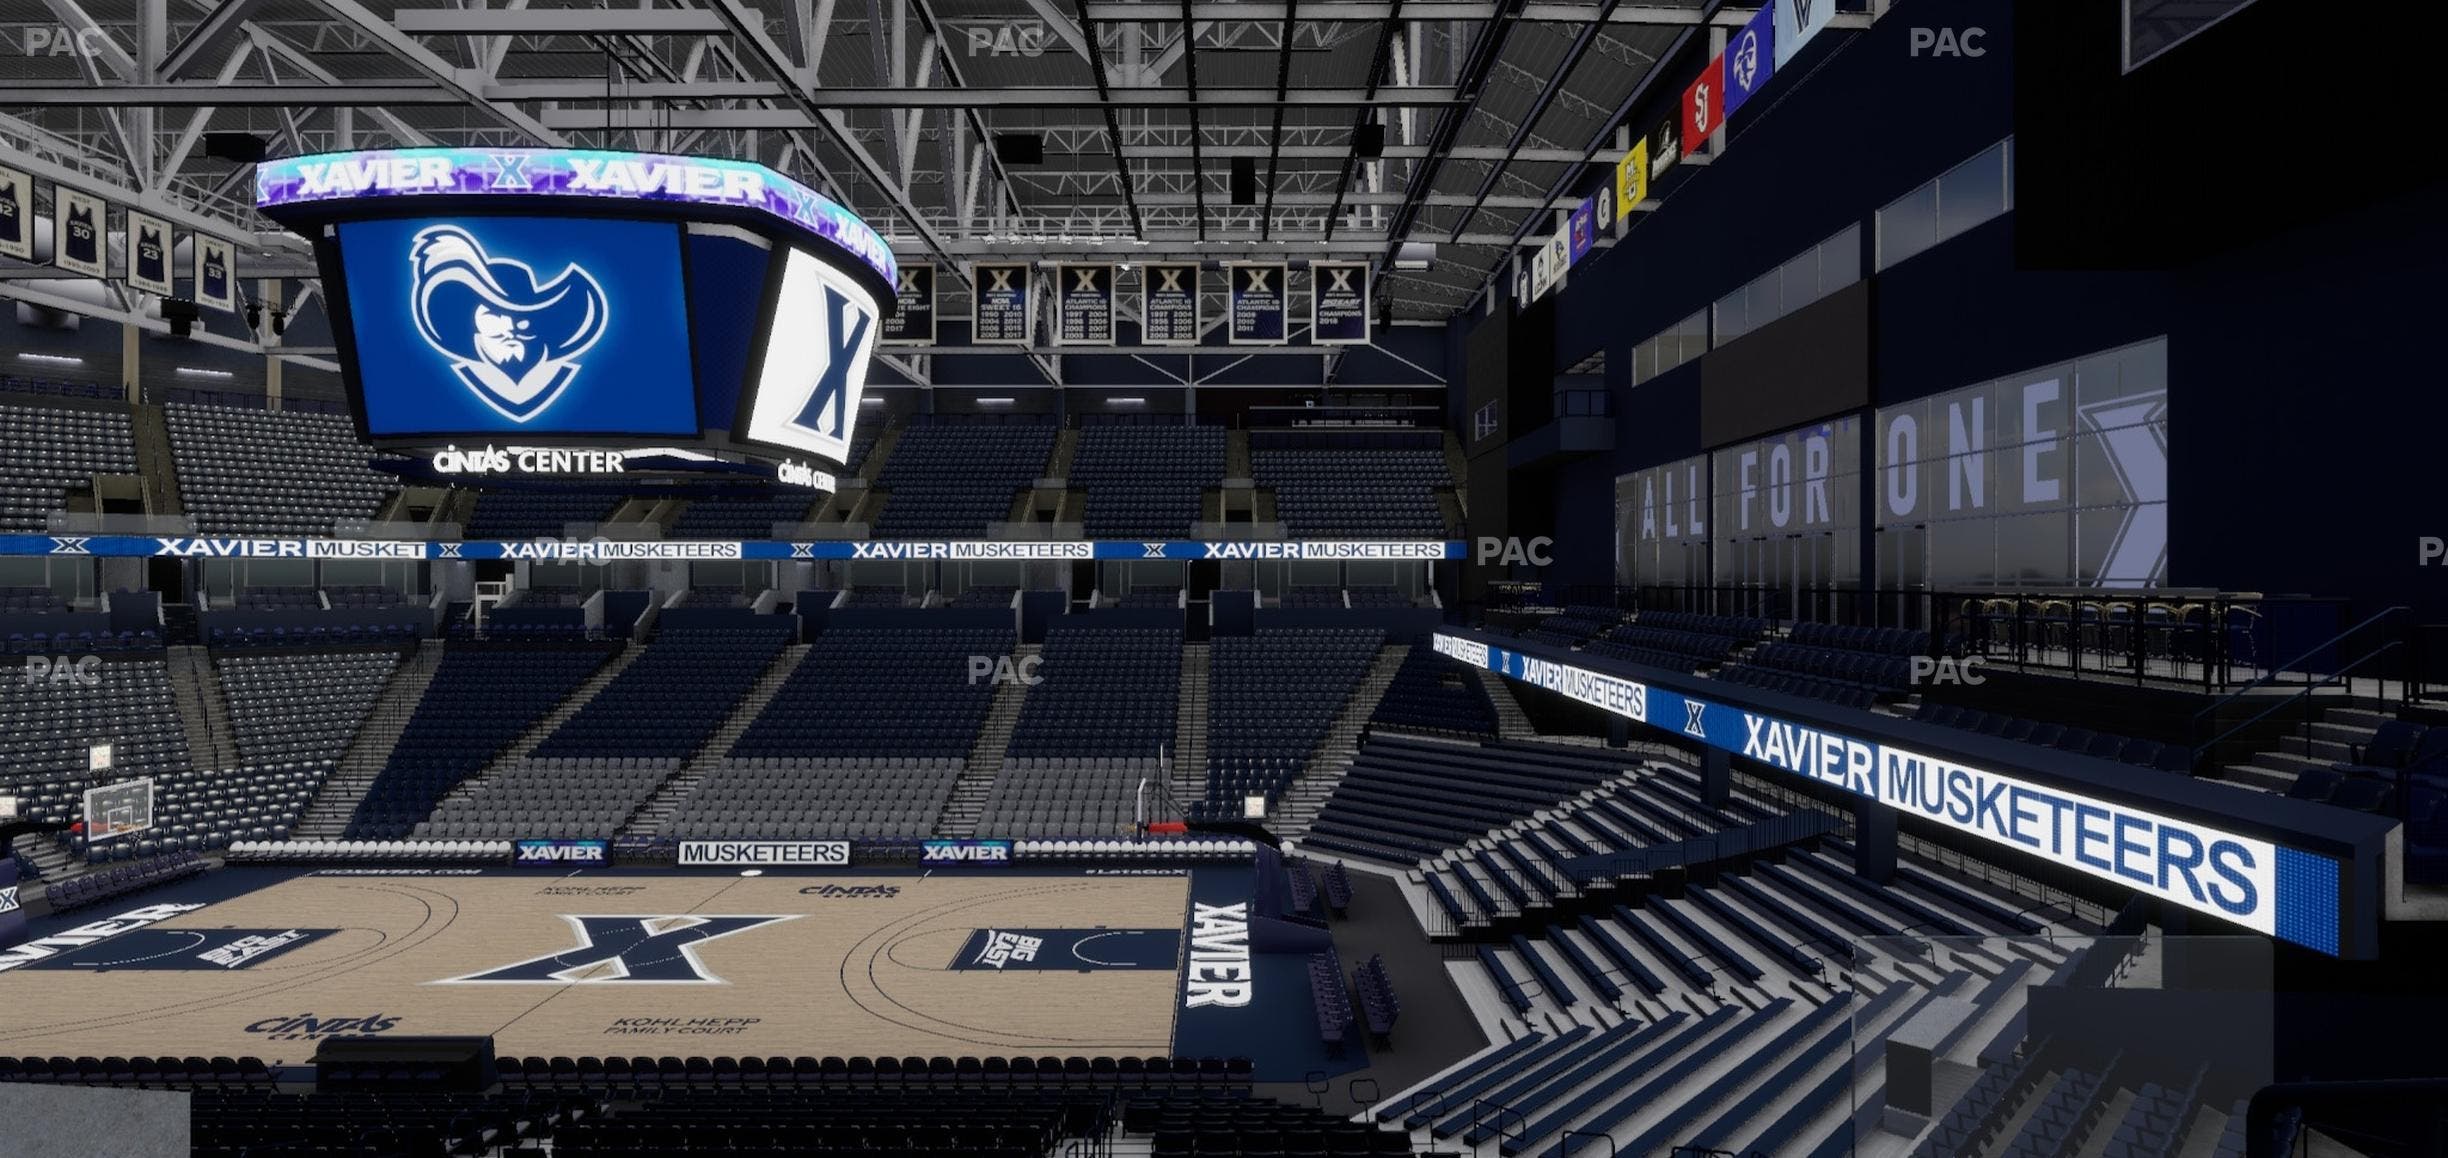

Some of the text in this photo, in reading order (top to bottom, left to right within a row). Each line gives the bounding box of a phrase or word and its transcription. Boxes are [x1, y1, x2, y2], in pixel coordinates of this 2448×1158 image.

[298, 156, 455, 195] XAVIER
[566, 157, 766, 203] XAVIER
[73, 226, 90, 240] 30
[834, 212, 887, 274] XAVIER
[143, 247, 159, 260] 23
[208, 267, 222, 279] 33
[784, 275, 872, 445] X
[518, 450, 625, 473] CENTER
[1642, 378, 2060, 540] ALL FOR ONE
[155, 538, 422, 557] XAVIER MUSKET
[500, 543, 738, 559] XAVIER MUSKETEERS
[851, 543, 1089, 558] XAVIER MUSKETEERS
[1204, 543, 1441, 558] XAVIER MUSKETEERS
[1522, 656, 1643, 717] XAVIER MUSKETEERS
[1743, 713, 2258, 916] XAVIER MUSKETEERS
[519, 845, 602, 860] XAVIER
[684, 844, 844, 863] MUSKETEERS
[922, 845, 1008, 861] XAVIER
[0, 903, 207, 972] VIER
[1010, 934, 1043, 962] BIG
[1186, 900, 1252, 1008] XAVIER
[613, 1018, 762, 1027] KOHLHEPP
